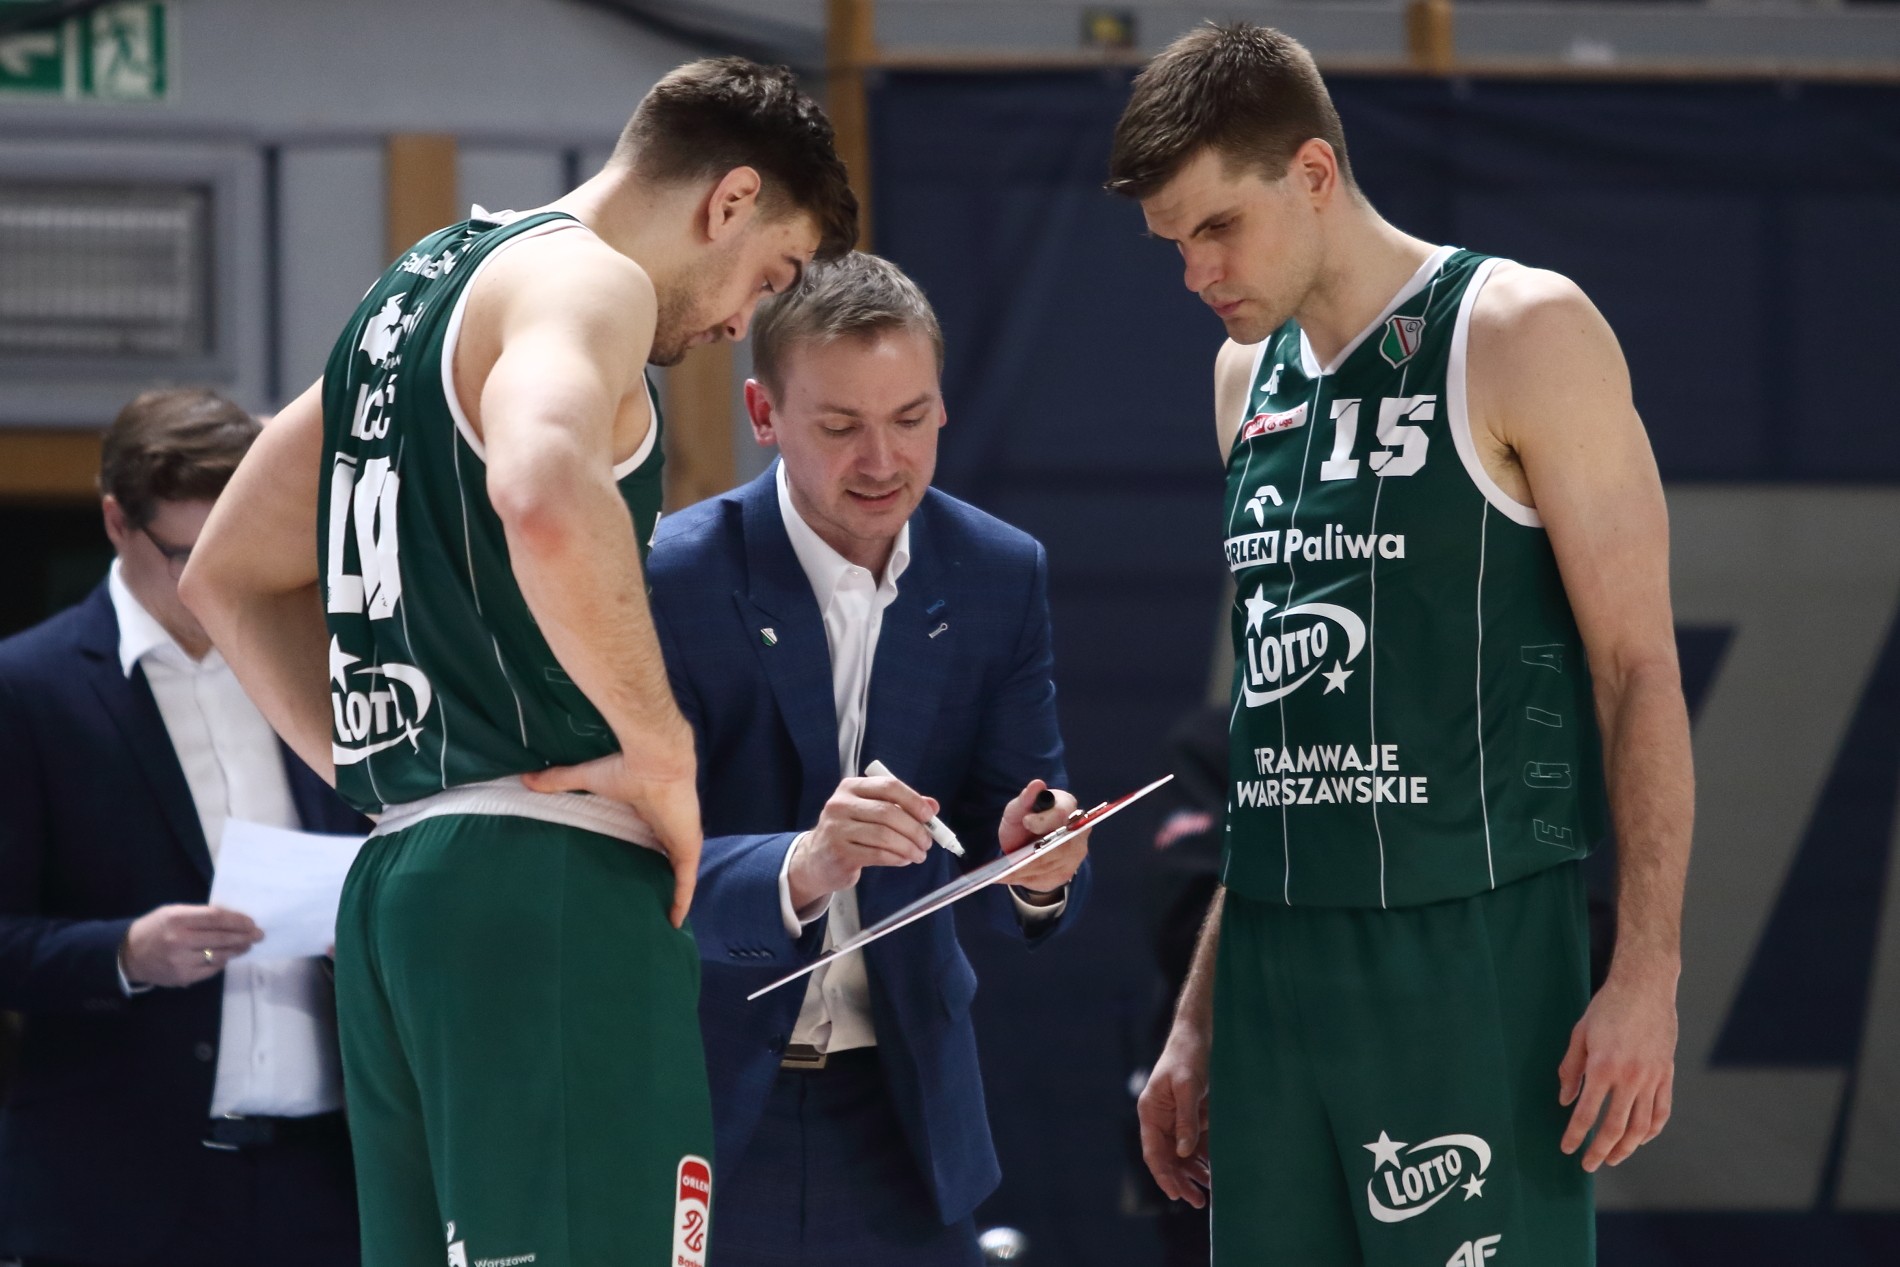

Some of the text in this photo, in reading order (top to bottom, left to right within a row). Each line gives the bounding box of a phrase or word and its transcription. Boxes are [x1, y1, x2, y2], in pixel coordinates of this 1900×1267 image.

[1320, 395, 1437, 482] 15
[1284, 524, 1405, 563] Paliwa
[1248, 622, 1328, 685] LOTTO
[1254, 744, 1400, 775] TRAMWAJE
[1237, 776, 1428, 808] WARSZAWSKIE
[682, 1175, 709, 1193] ORLEN
[1384, 1148, 1463, 1206] LOTTO
[474, 1253, 537, 1267] Warszawa
